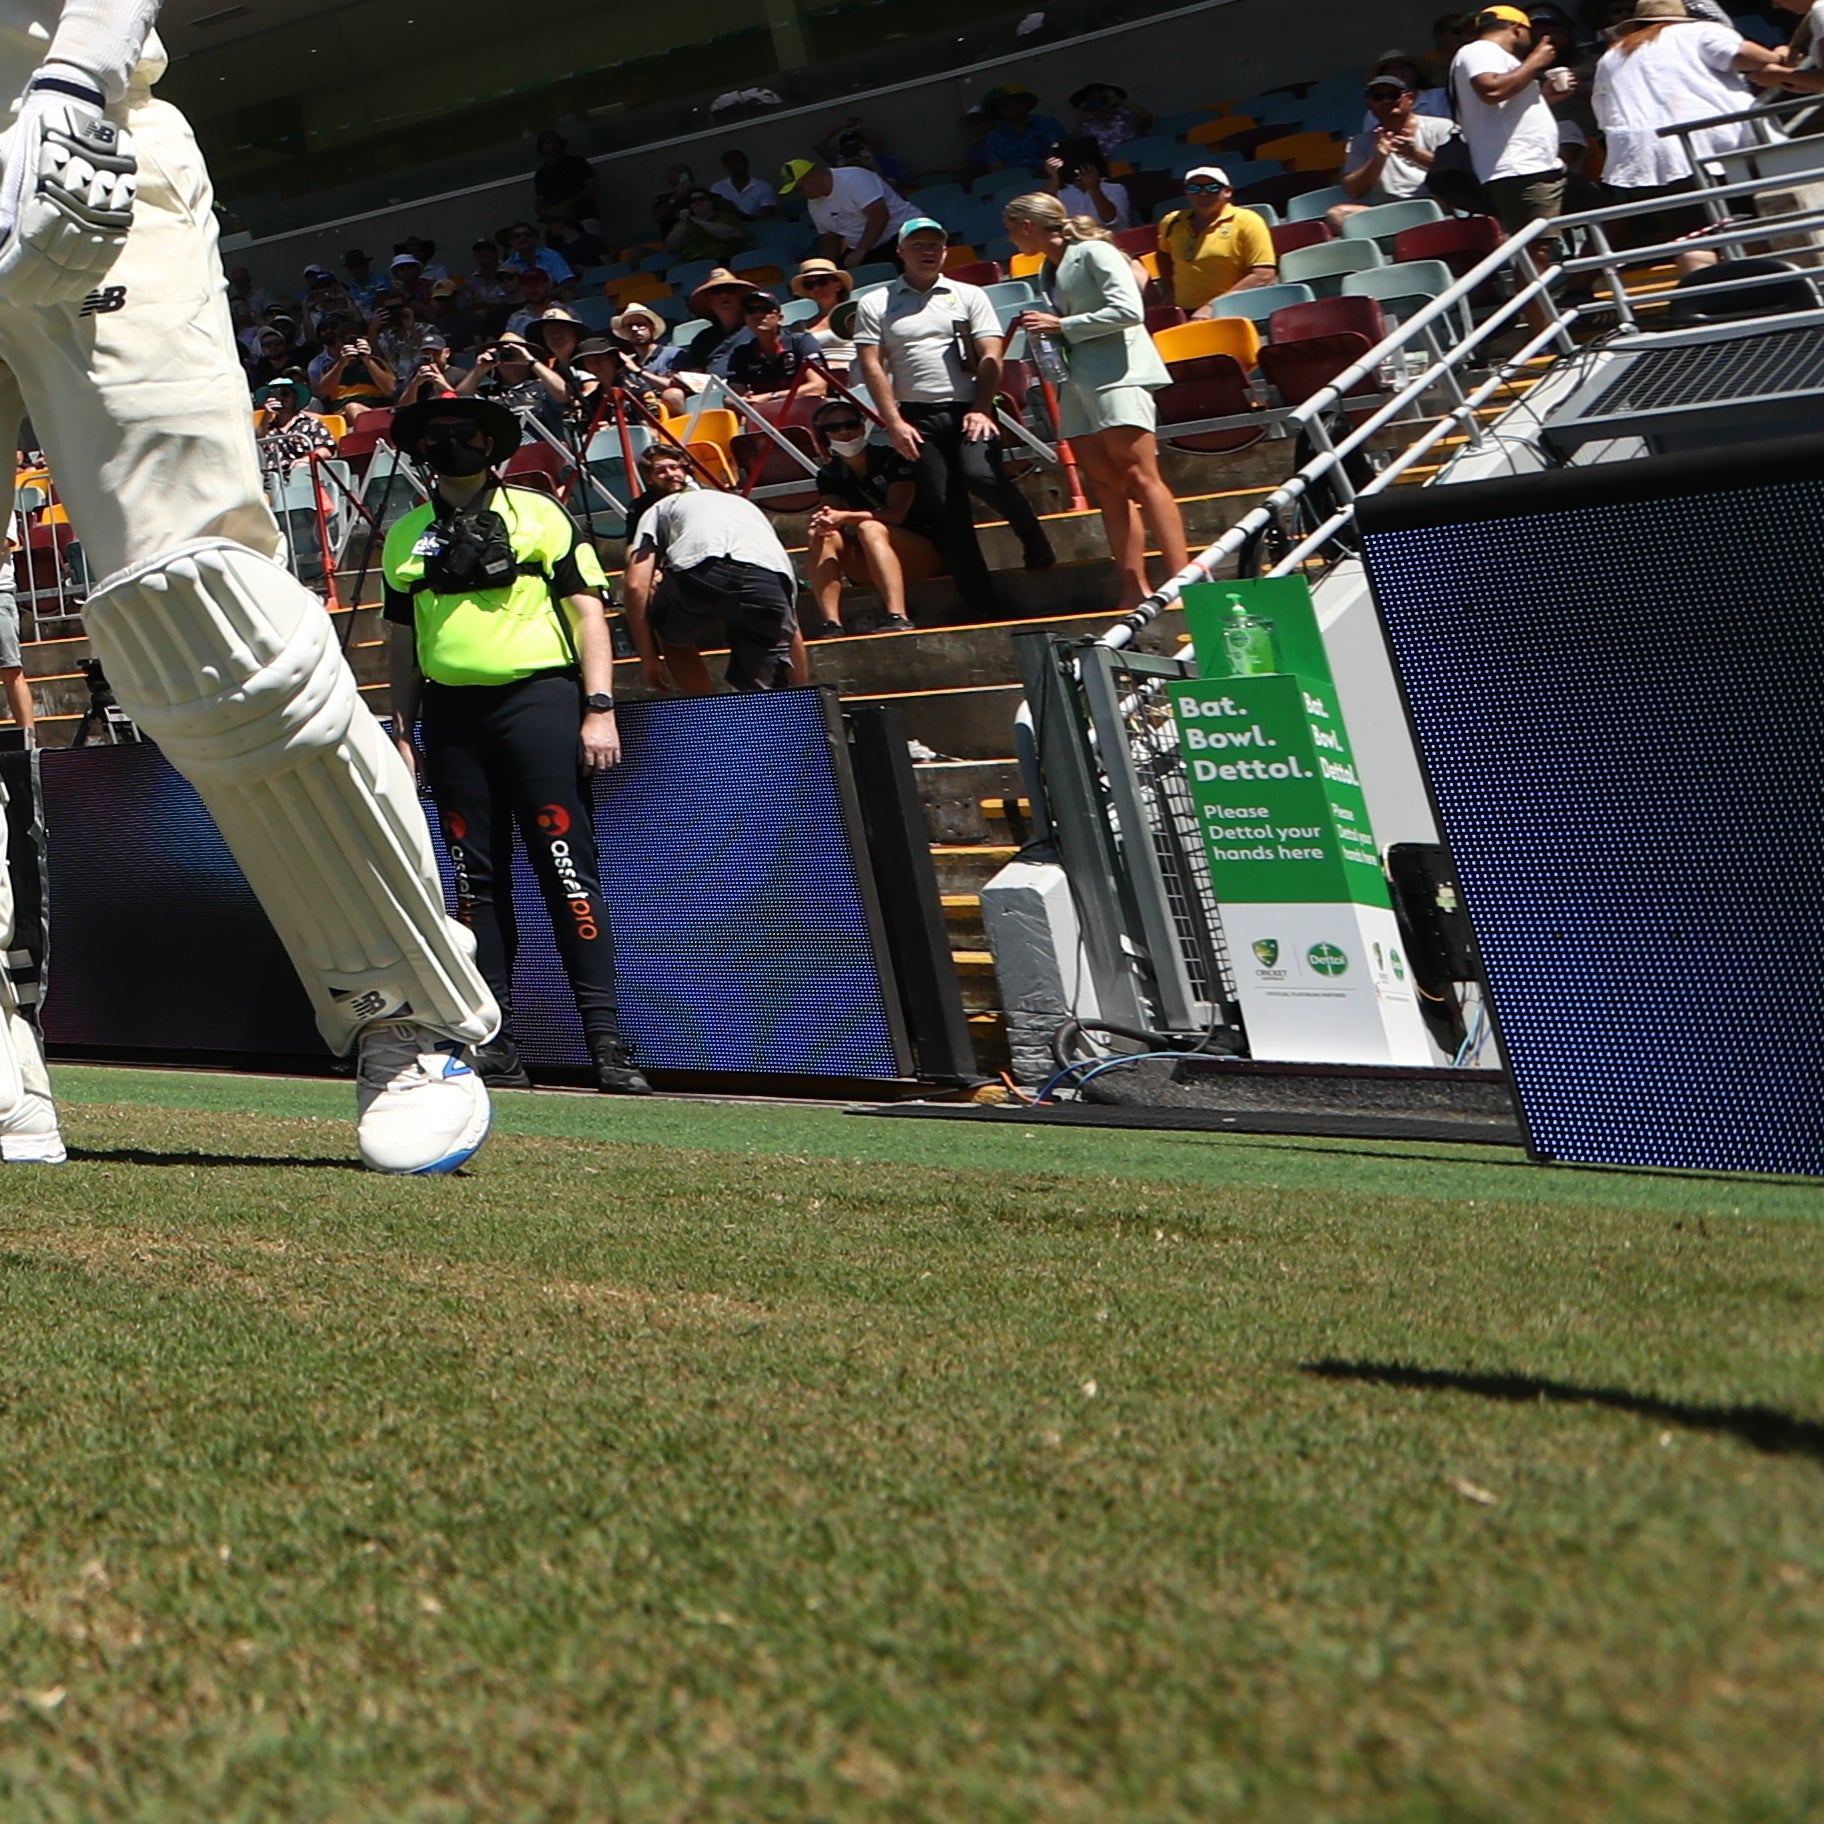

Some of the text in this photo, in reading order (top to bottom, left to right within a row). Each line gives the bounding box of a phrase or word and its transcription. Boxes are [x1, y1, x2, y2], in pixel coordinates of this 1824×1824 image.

[1178, 697, 1248, 718] Bat.
[1303, 691, 1329, 719] Bat.
[1185, 725, 1277, 750] Bowl.
[1311, 724, 1344, 753] Bowl.
[1193, 756, 1313, 782] Dettol.
[1320, 756, 1360, 787] Dettol.
[1203, 805, 1270, 819] Please
[1209, 825, 1321, 842] Dettol your
[1213, 845, 1324, 860] hands here
[550, 840, 599, 940] assetpro
[1309, 953, 1346, 965] Dettol
